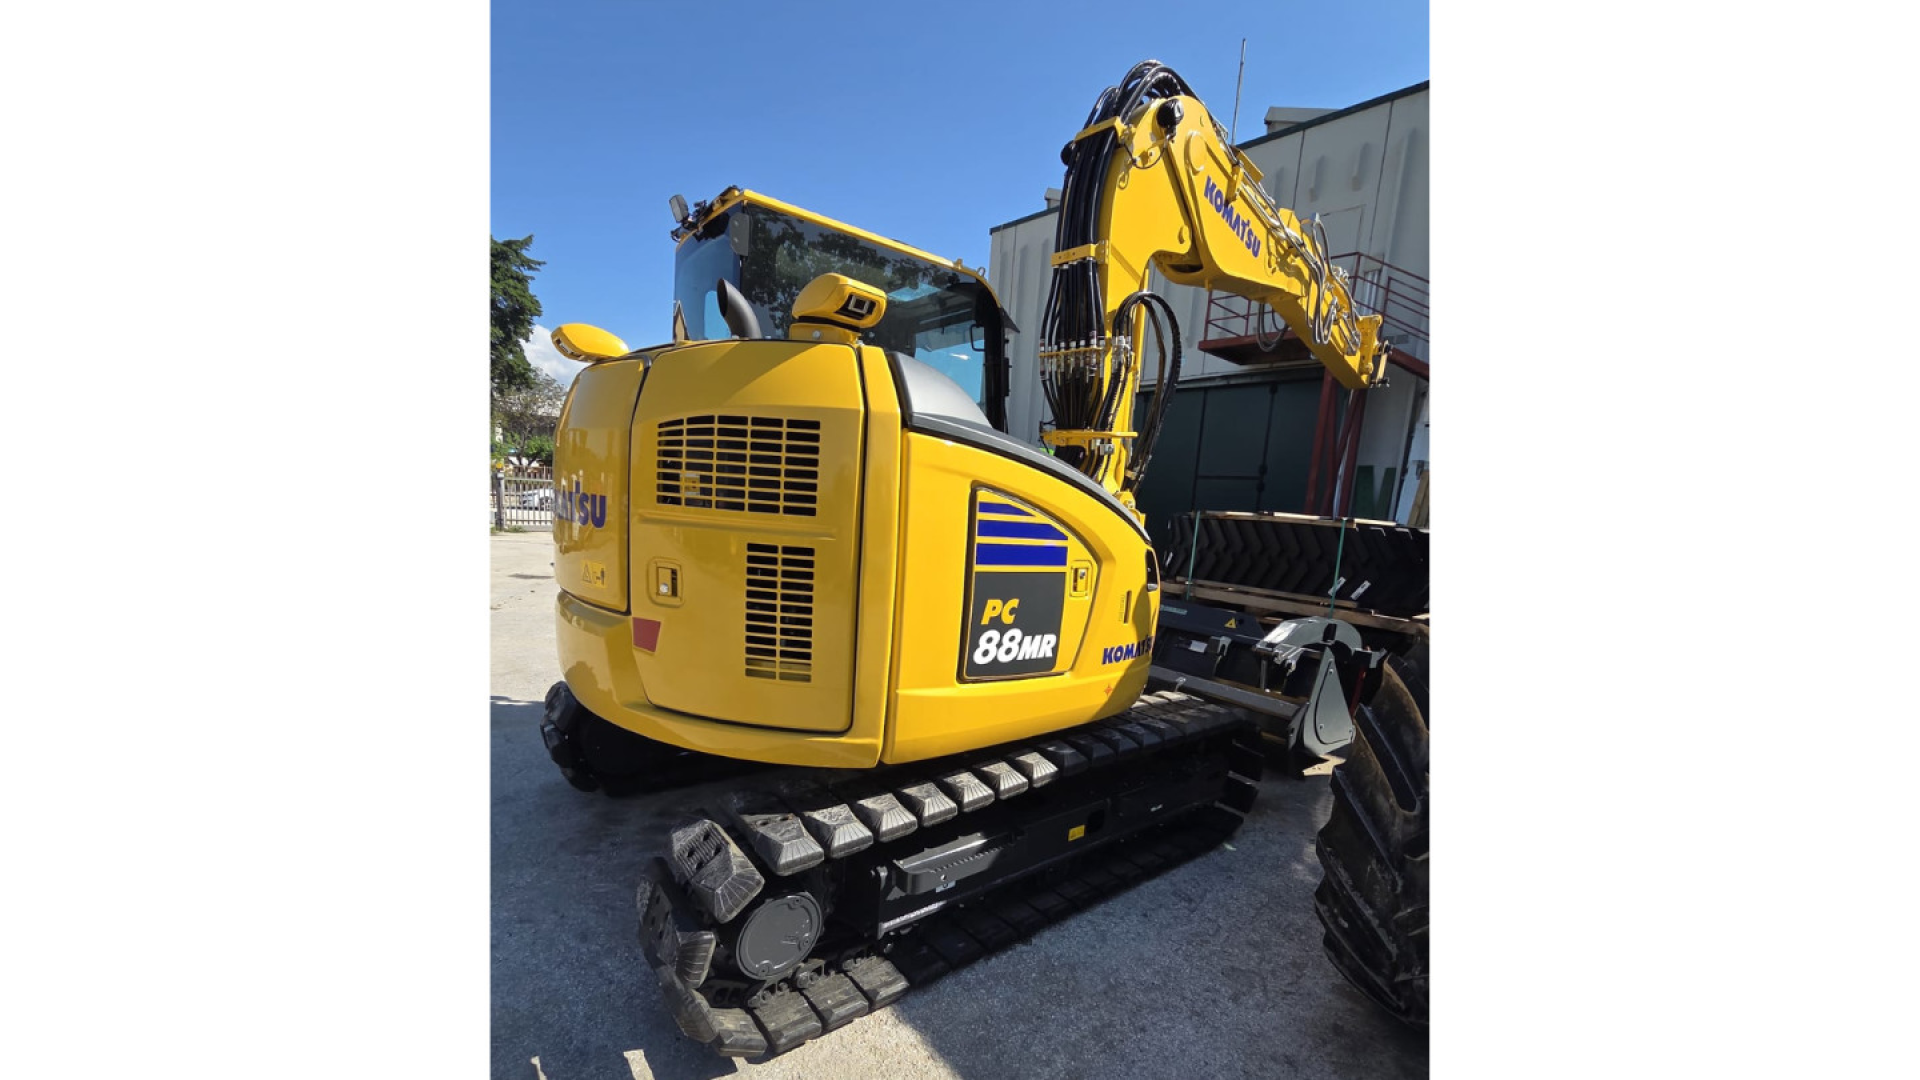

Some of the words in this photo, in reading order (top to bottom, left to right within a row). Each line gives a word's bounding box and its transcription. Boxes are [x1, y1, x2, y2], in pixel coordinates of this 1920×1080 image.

[1204, 175, 1261, 258] KOMATSU
[555, 480, 607, 528] ATSU
[981, 598, 1020, 625] PC
[973, 628, 1057, 664] 88MR
